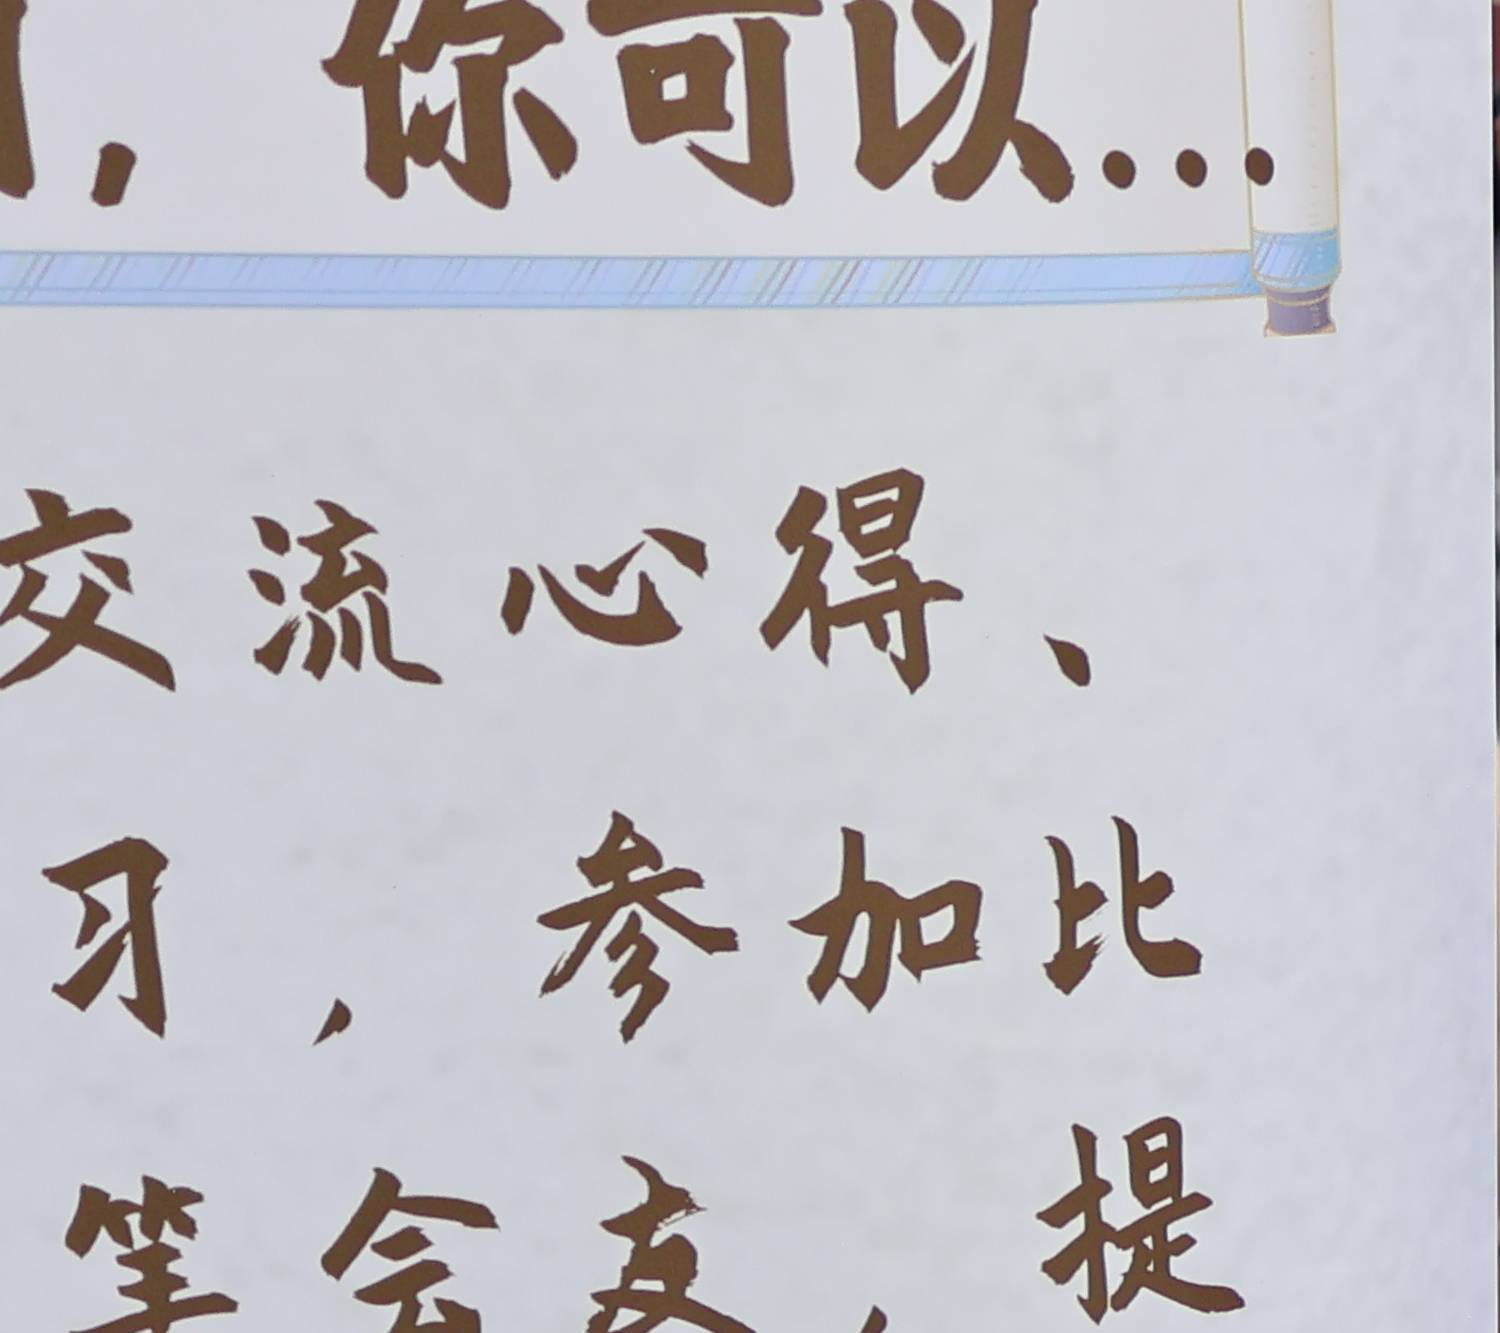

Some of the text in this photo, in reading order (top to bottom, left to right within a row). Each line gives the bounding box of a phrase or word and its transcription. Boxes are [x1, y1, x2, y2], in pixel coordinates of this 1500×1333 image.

[0, 0, 1272, 208] ，你可以...
[0, 469, 1092, 696] 交流心得、
[42, 811, 1204, 1045] 习，参加比
